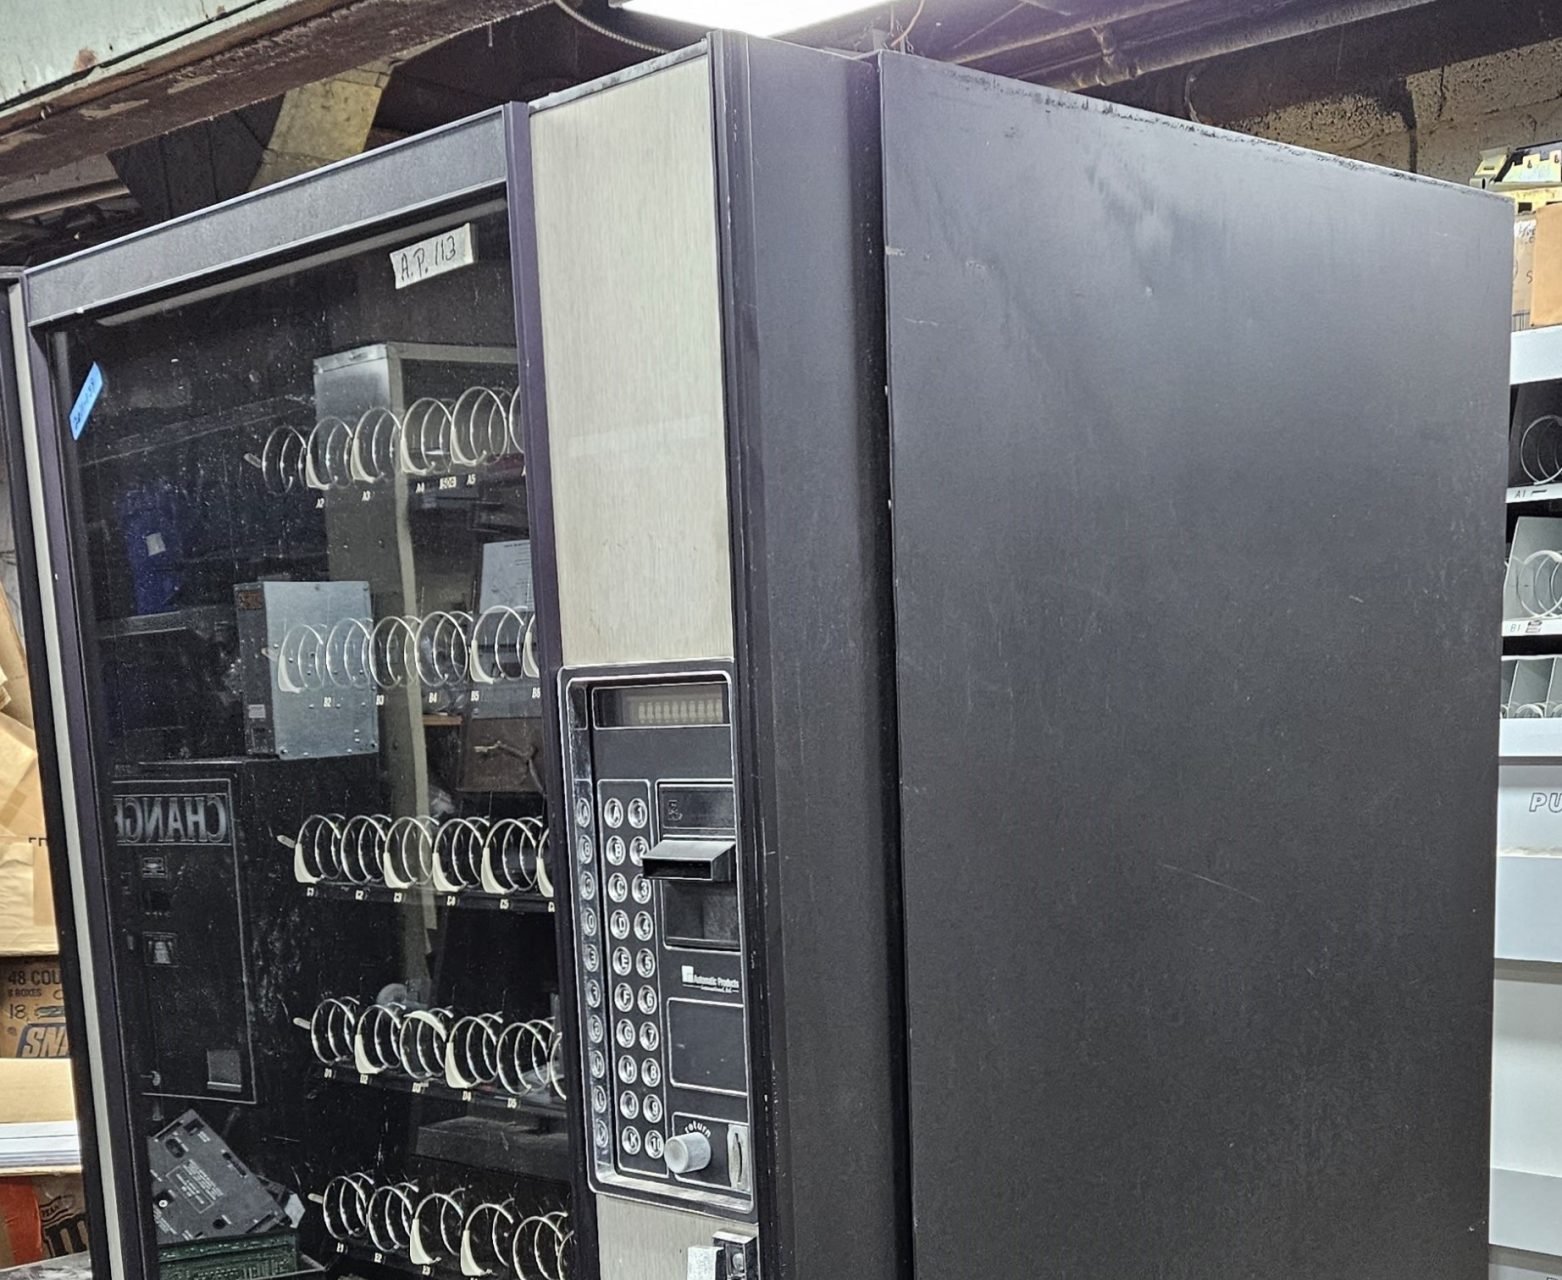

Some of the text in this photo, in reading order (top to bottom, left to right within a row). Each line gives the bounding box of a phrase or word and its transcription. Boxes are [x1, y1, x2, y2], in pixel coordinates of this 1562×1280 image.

[401, 235, 456, 282] A.P. 113
[8, 970, 27, 985] 48
[684, 1120, 711, 1138] return
